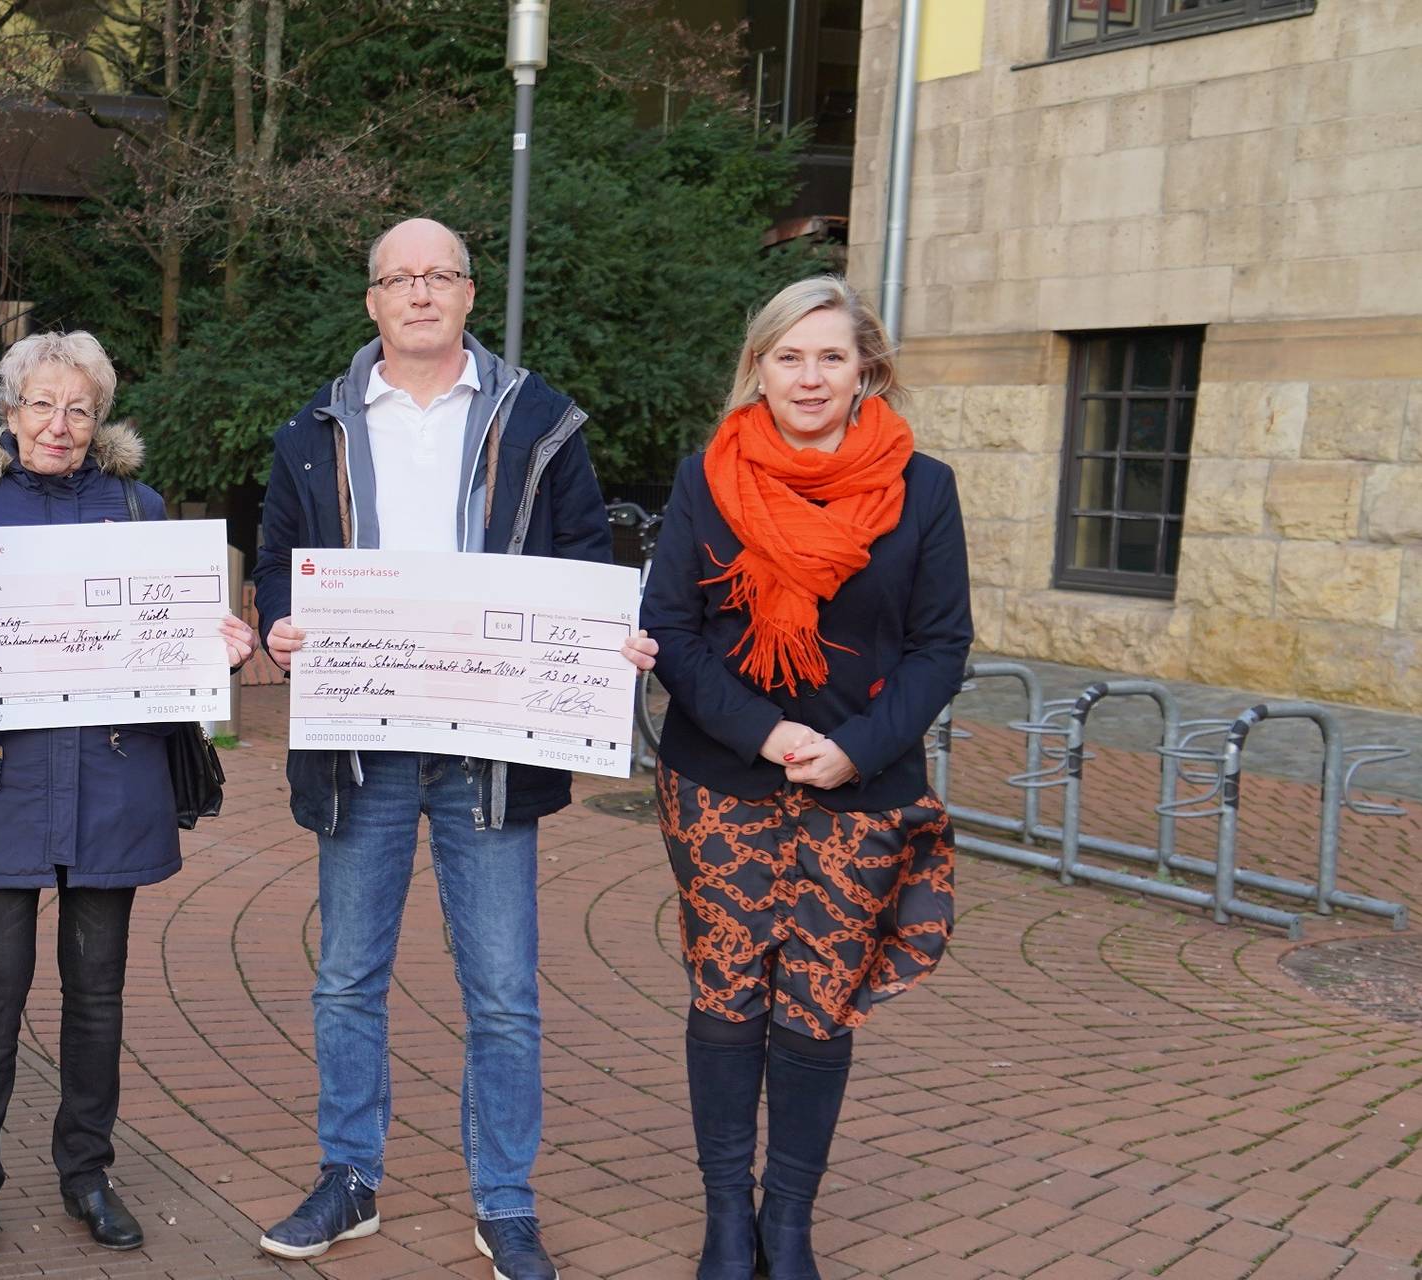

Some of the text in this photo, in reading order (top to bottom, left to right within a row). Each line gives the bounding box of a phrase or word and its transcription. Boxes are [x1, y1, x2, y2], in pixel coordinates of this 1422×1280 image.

[321, 567, 399, 577] Kreissparkasse
[320, 580, 344, 589] Köln
[95, 589, 111, 597] EUR
[495, 622, 512, 630] EUR
